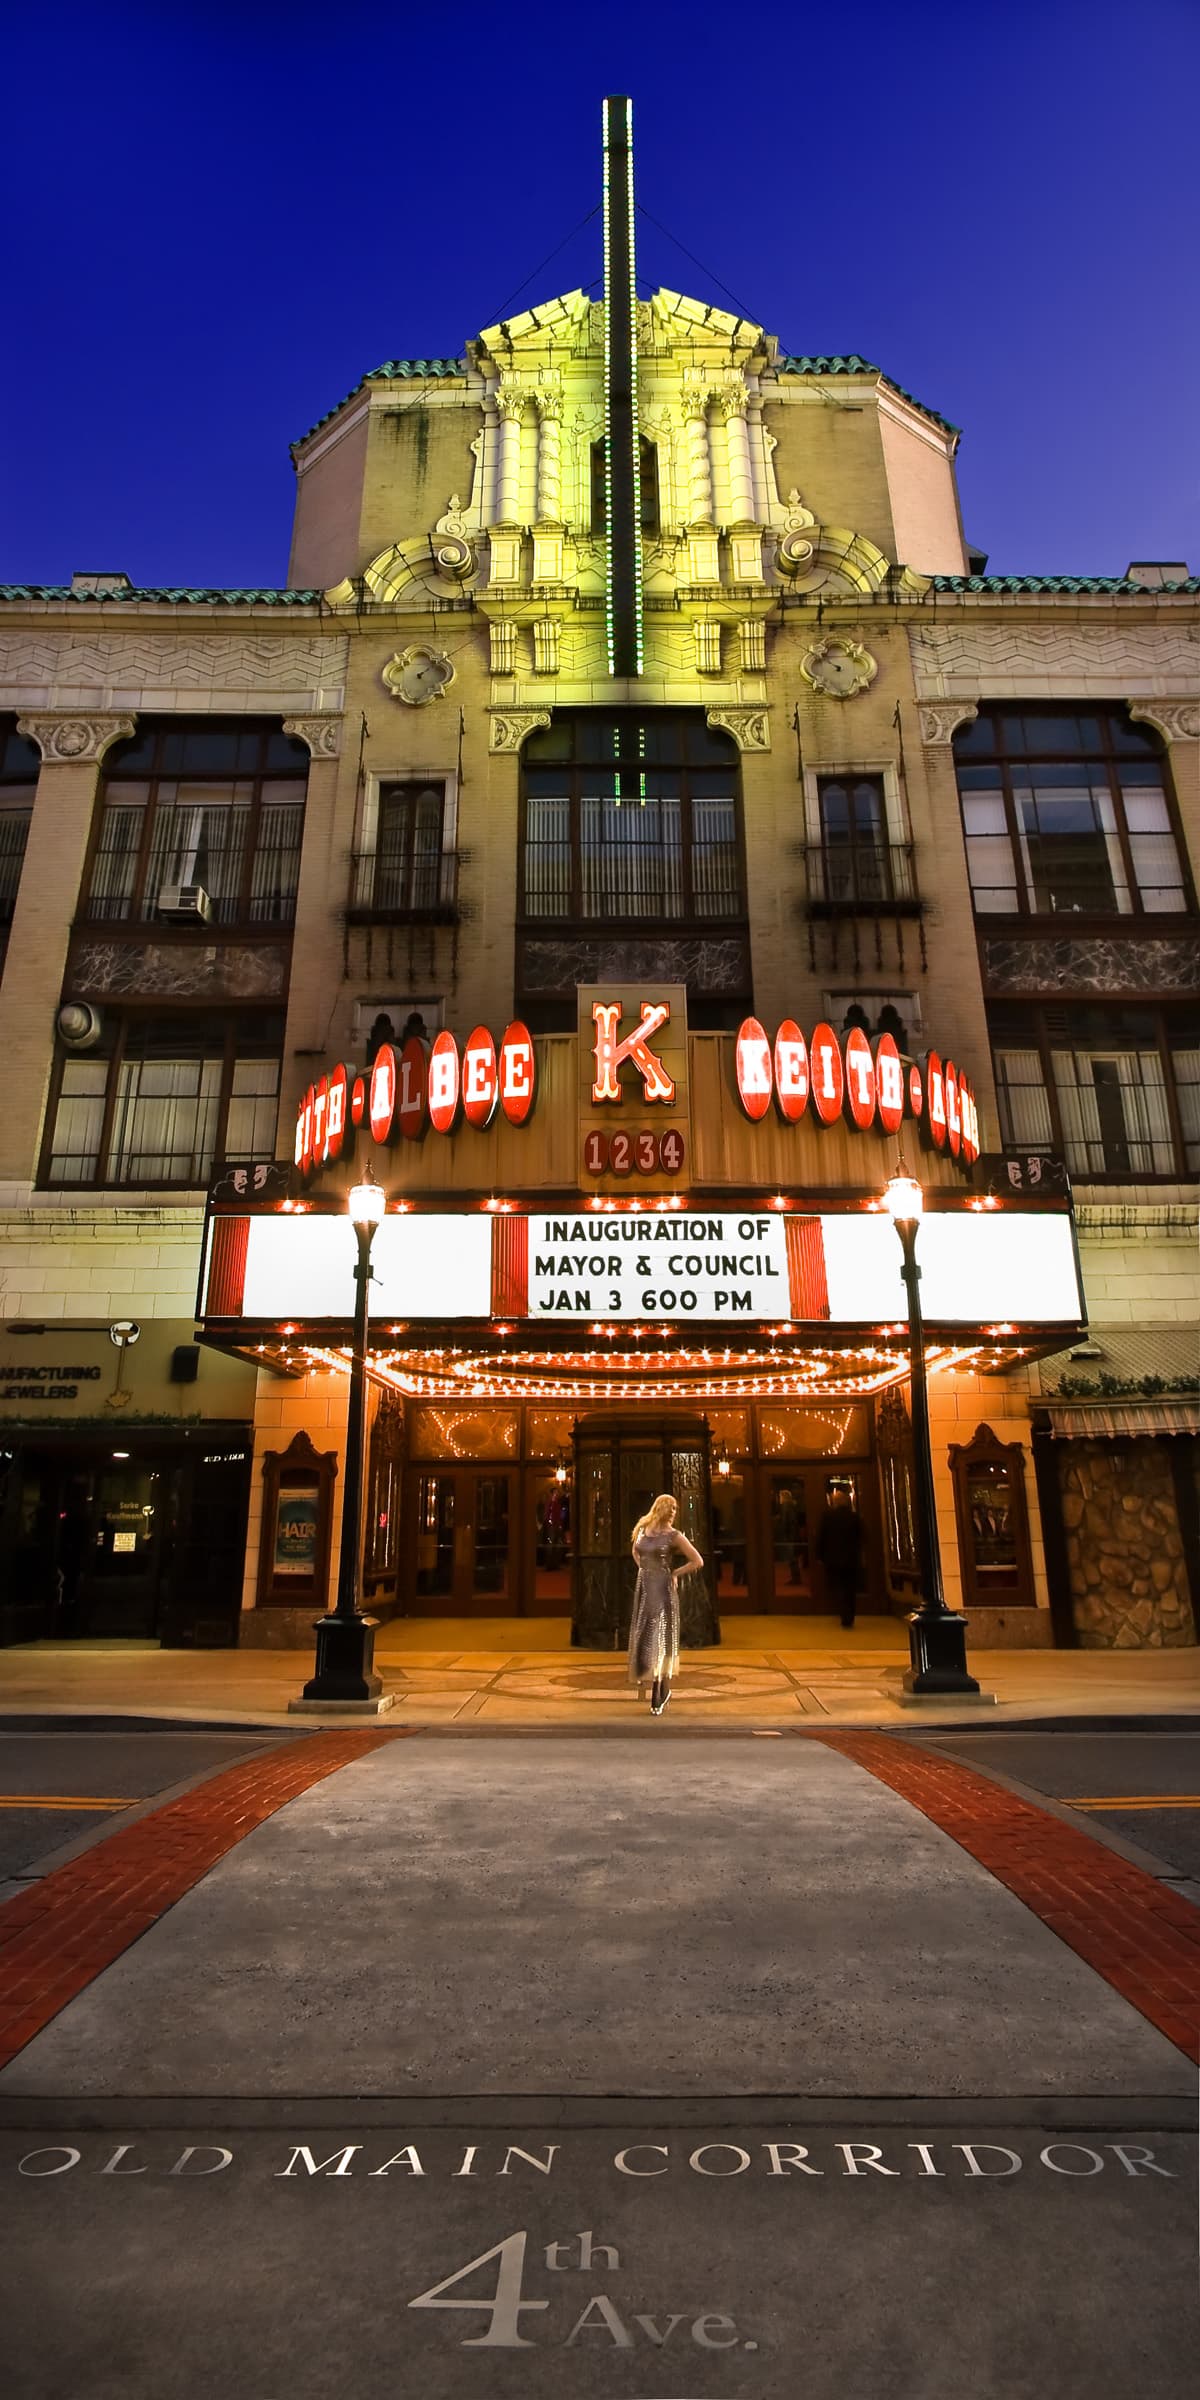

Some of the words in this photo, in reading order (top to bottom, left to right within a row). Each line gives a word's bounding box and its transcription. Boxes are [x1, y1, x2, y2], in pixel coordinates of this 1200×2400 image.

[592, 1001, 675, 1104] K
[294, 1043, 530, 1166] EITH-ALBEE
[588, 1135, 680, 1169] 1234
[546, 1220, 722, 1241] INAUGURATION
[738, 1220, 770, 1240] OF
[536, 1256, 621, 1276] MAYOR
[637, 1256, 650, 1275] &
[669, 1256, 778, 1275] COUNCIL
[540, 1290, 590, 1310] JAN
[609, 1291, 621, 1310] 3
[642, 1290, 697, 1310] 600
[715, 1291, 752, 1310] PM
[280, 1522, 316, 1538] HAIR
[17, 2145, 234, 2177] OLD
[273, 2144, 562, 2177] MAIN
[613, 2143, 1180, 2177] CORRIDOR
[407, 2230, 621, 2347] 4th
[561, 2294, 759, 2350] Ave.
